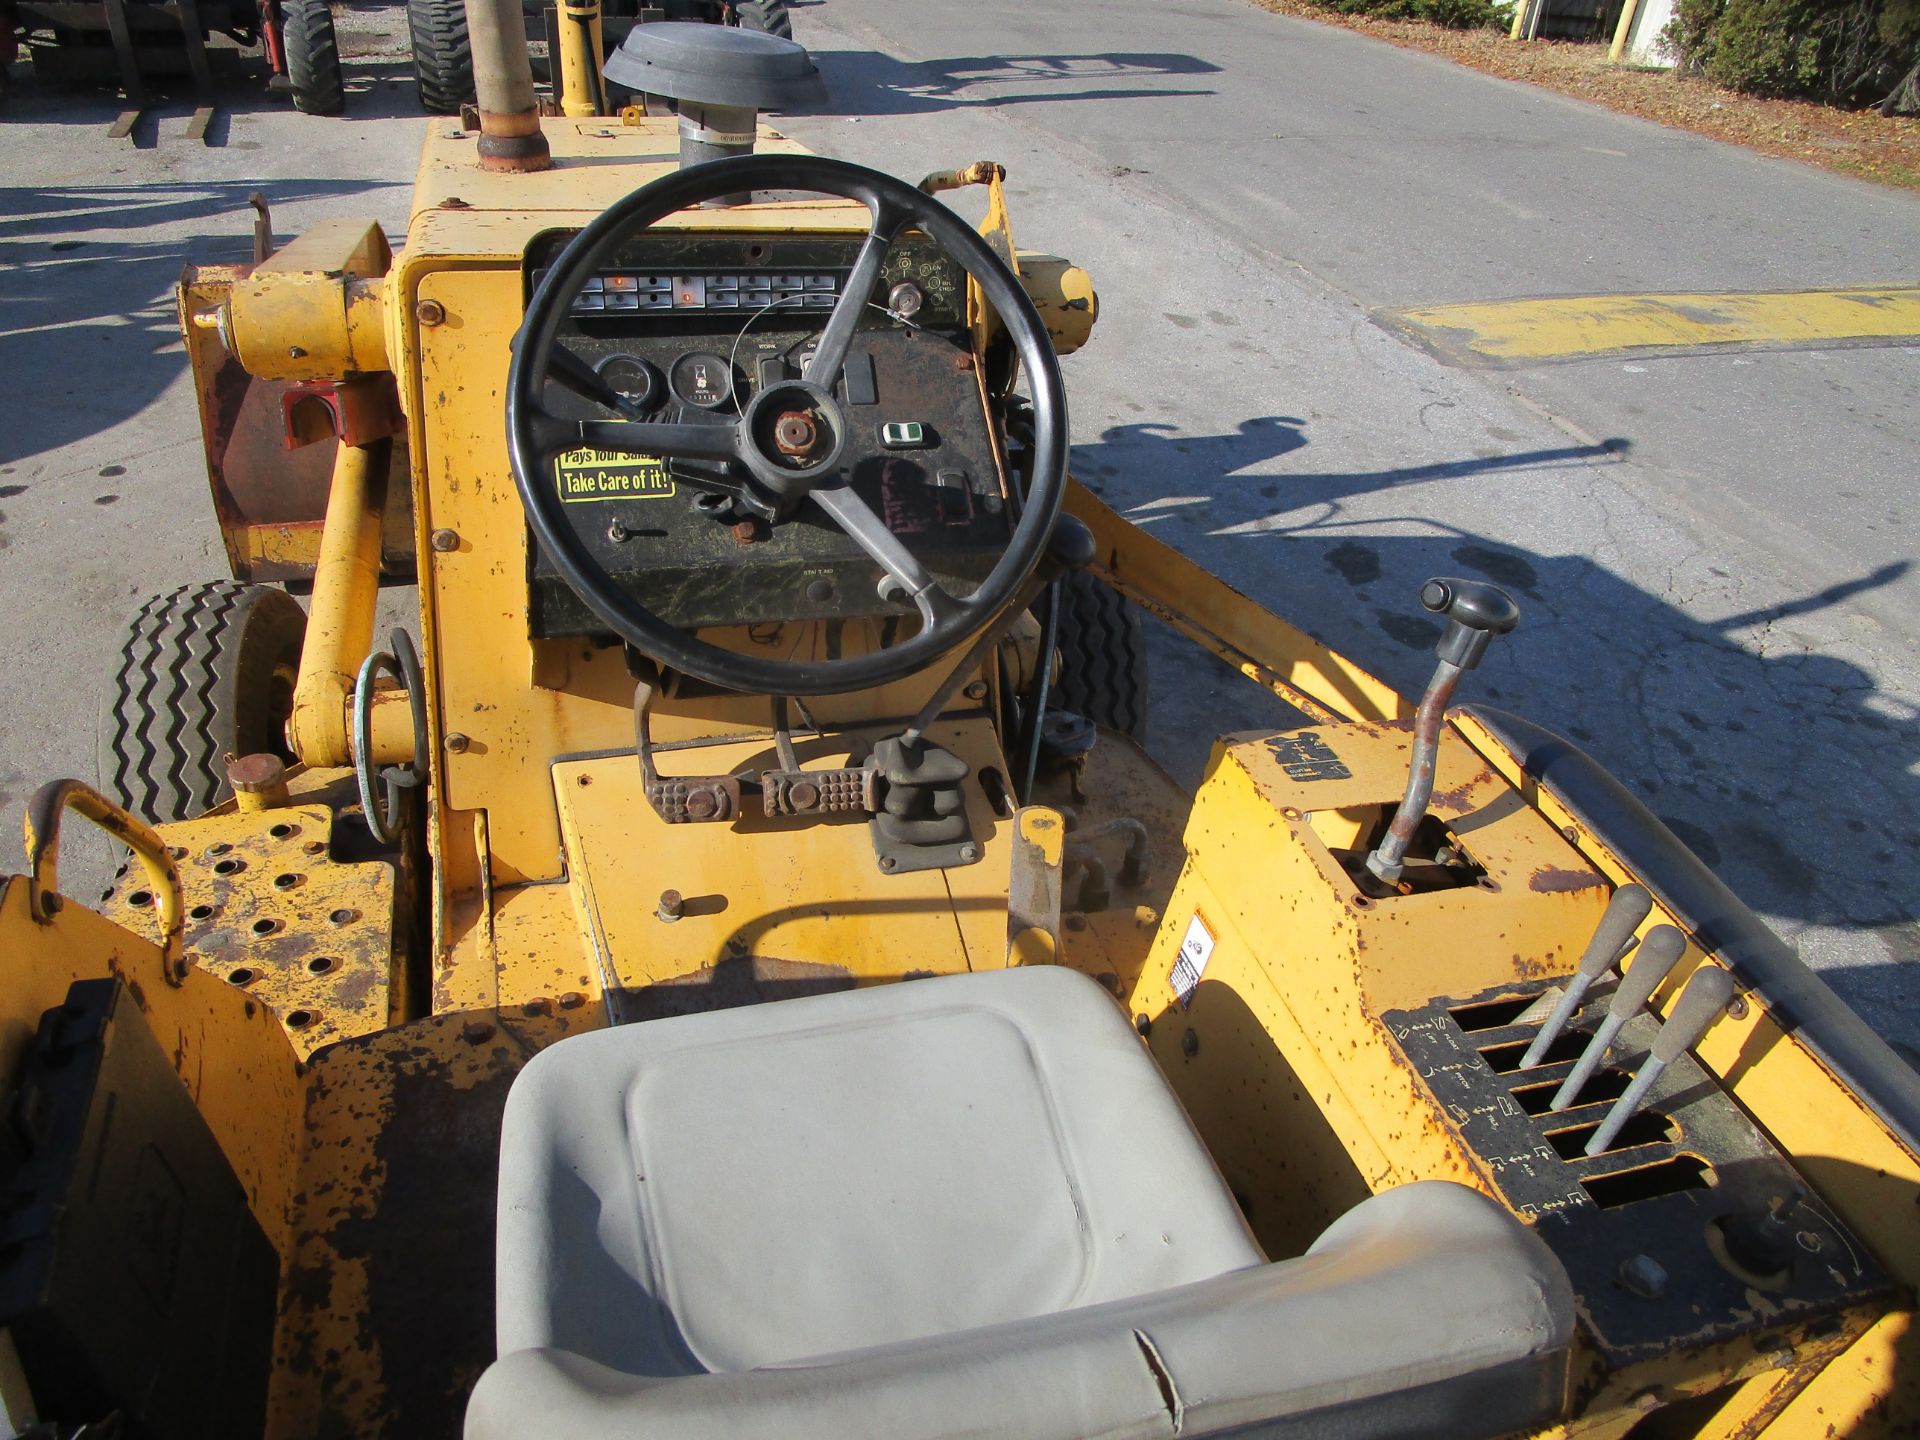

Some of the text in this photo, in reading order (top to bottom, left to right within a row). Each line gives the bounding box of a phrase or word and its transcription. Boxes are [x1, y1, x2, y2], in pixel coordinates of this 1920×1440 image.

[565, 450, 592, 465] Pays
[564, 468, 668, 493] Take Care of it!
[1426, 1032, 1438, 1044] LIFT
[1444, 1033, 1460, 1050] FLOAT
[1455, 1071, 1471, 1089] PITCH
[1523, 1163, 1536, 1177] AUX
